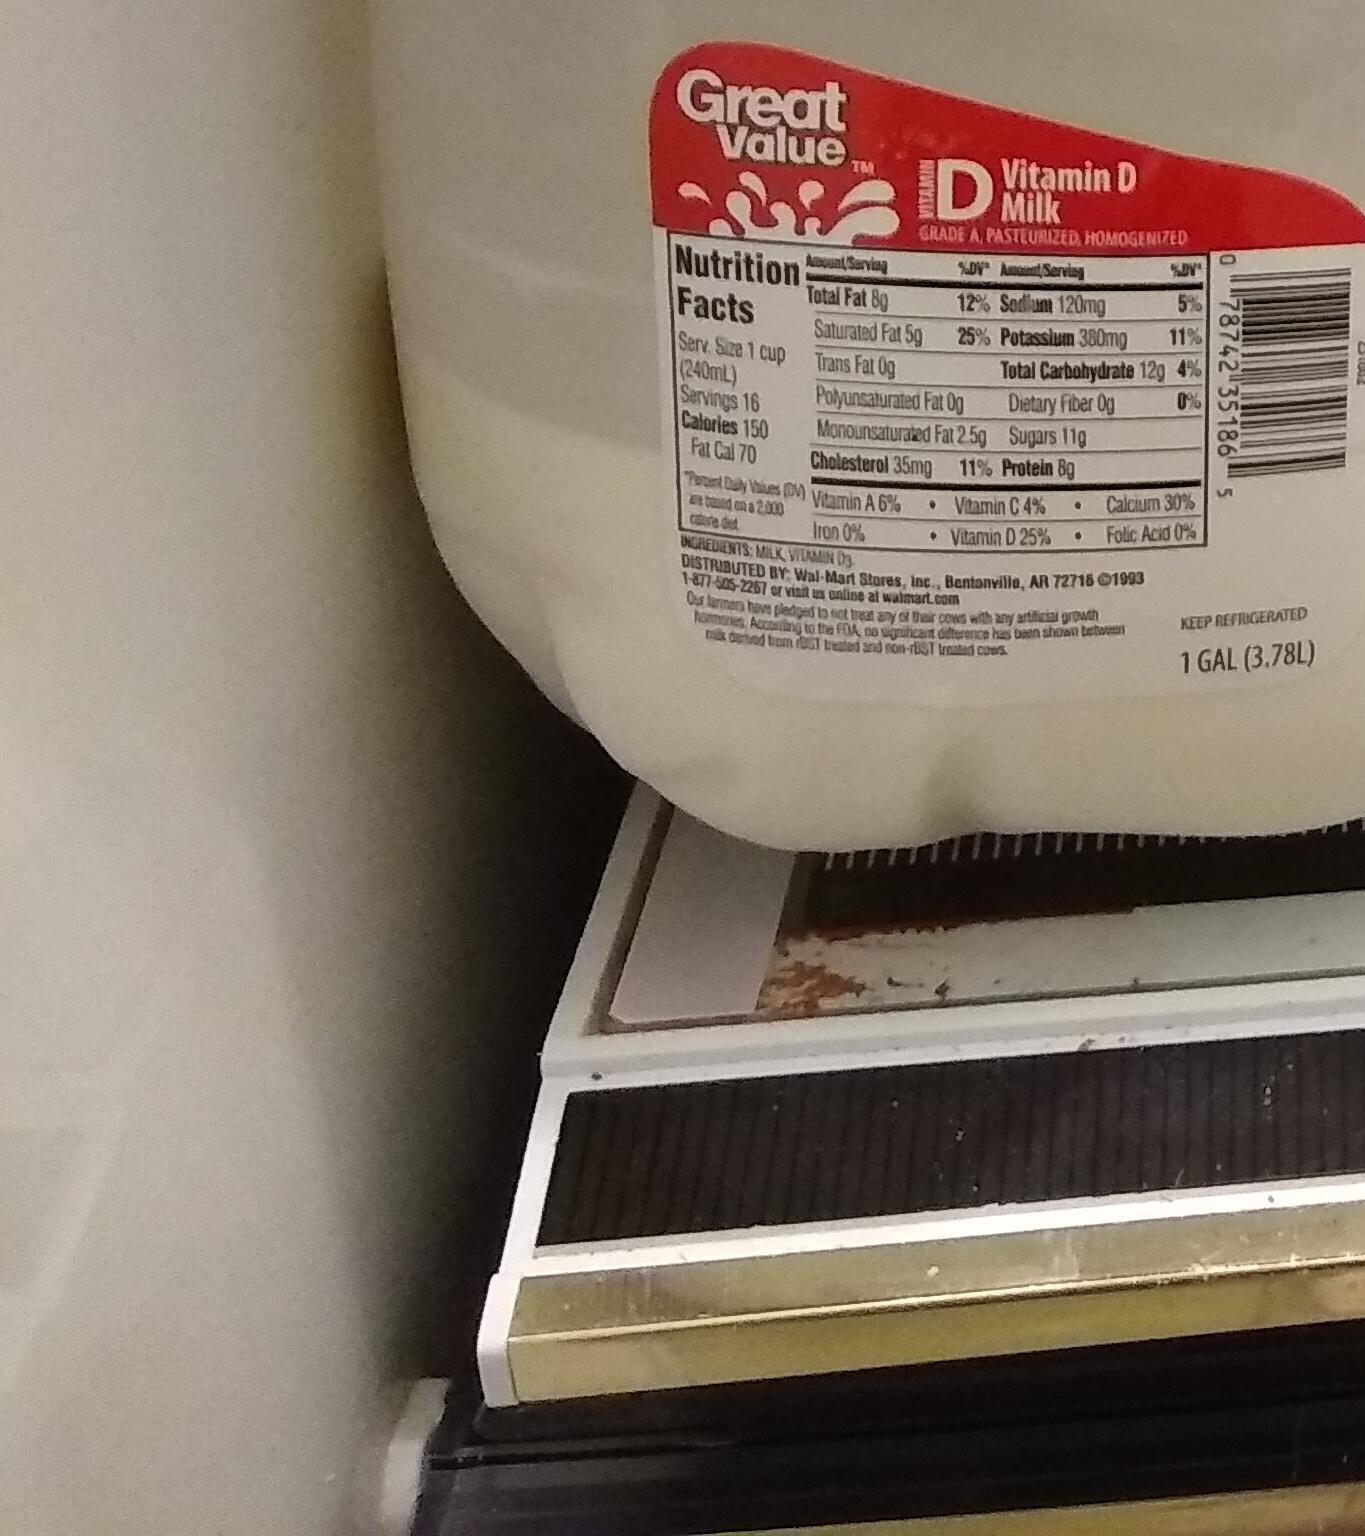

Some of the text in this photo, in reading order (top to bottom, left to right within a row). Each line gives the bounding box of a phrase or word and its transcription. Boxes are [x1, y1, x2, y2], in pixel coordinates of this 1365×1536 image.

[677, 68, 848, 133] Great
[716, 124, 847, 167] Value
[1001, 157, 1137, 194] Vitamin D
[937, 158, 993, 221] D
[1000, 191, 1061, 225] Milk
[918, 225, 965, 243] GRADE
[675, 243, 800, 287] Nutrition
[677, 286, 755, 324] Facts
[806, 284, 991, 314] Total Fat 8g 12%
[1000, 294, 1202, 317] Sodium 120mg 5%
[814, 319, 991, 347] Saturated Fat 5g 25%
[1000, 327, 1202, 351] Potassium 380mg 11%
[678, 331, 711, 355] Serv.
[715, 336, 743, 357] Size
[759, 345, 786, 366] cup
[680, 361, 737, 387] (240mL)
[816, 352, 896, 379] Trans Fat 0g
[1001, 360, 1202, 384] Total Carbohydrate 12g 4%
[680, 385, 760, 413] Servings 16
[816, 385, 964, 415] Polyunsaturated Fat 0g
[1008, 392, 1202, 416] Dietary Fiber 0g 0%
[681, 410, 769, 441] Calories 150
[817, 419, 987, 448] Monounsaturated Fat 2.5g
[1009, 425, 1087, 448] Sugars 11g
[691, 437, 757, 464] Fat Cal 70
[810, 450, 993, 479] Cholesterol 35mg 11%
[1001, 457, 1075, 480] Protein 8g
[812, 490, 901, 513] Vitamin A 6%
[954, 496, 1046, 515] Vitamin C 4%
[1106, 493, 1196, 513] Calcium 30%
[813, 521, 865, 543] Iron 0%
[951, 526, 1051, 546] Vitamin D 25%
[1106, 524, 1197, 544] Folic Acid 0%
[682, 553, 766, 578] DISTRIBUTED
[794, 567, 856, 585] Wal-Mart
[1029, 575, 1049, 589] AR
[1180, 606, 1308, 630] KEEP REFRIGERATED
[1180, 639, 1316, 674] 1 GAL (3.78L)
